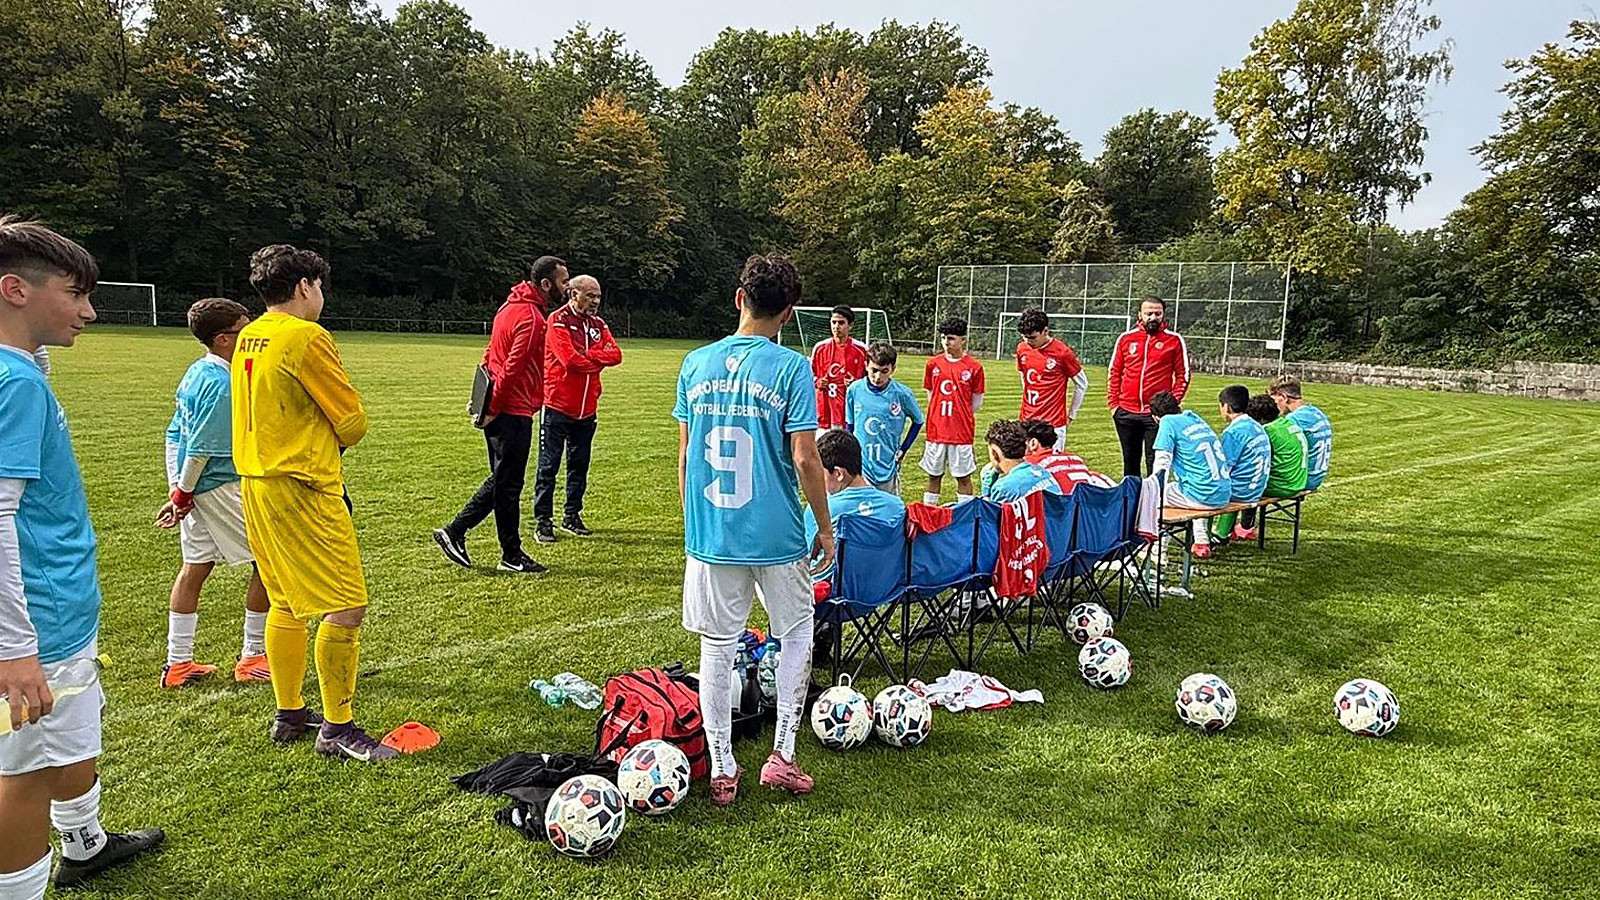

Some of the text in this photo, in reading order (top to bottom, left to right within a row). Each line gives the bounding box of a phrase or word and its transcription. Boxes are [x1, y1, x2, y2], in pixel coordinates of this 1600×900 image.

[238, 338, 270, 353] ATFF
[244, 358, 254, 432] 1
[828, 383, 837, 398] 8
[1027, 389, 1040, 406] 17
[940, 400, 953, 417] 11
[866, 443, 882, 461] 11
[704, 426, 753, 509] 9
